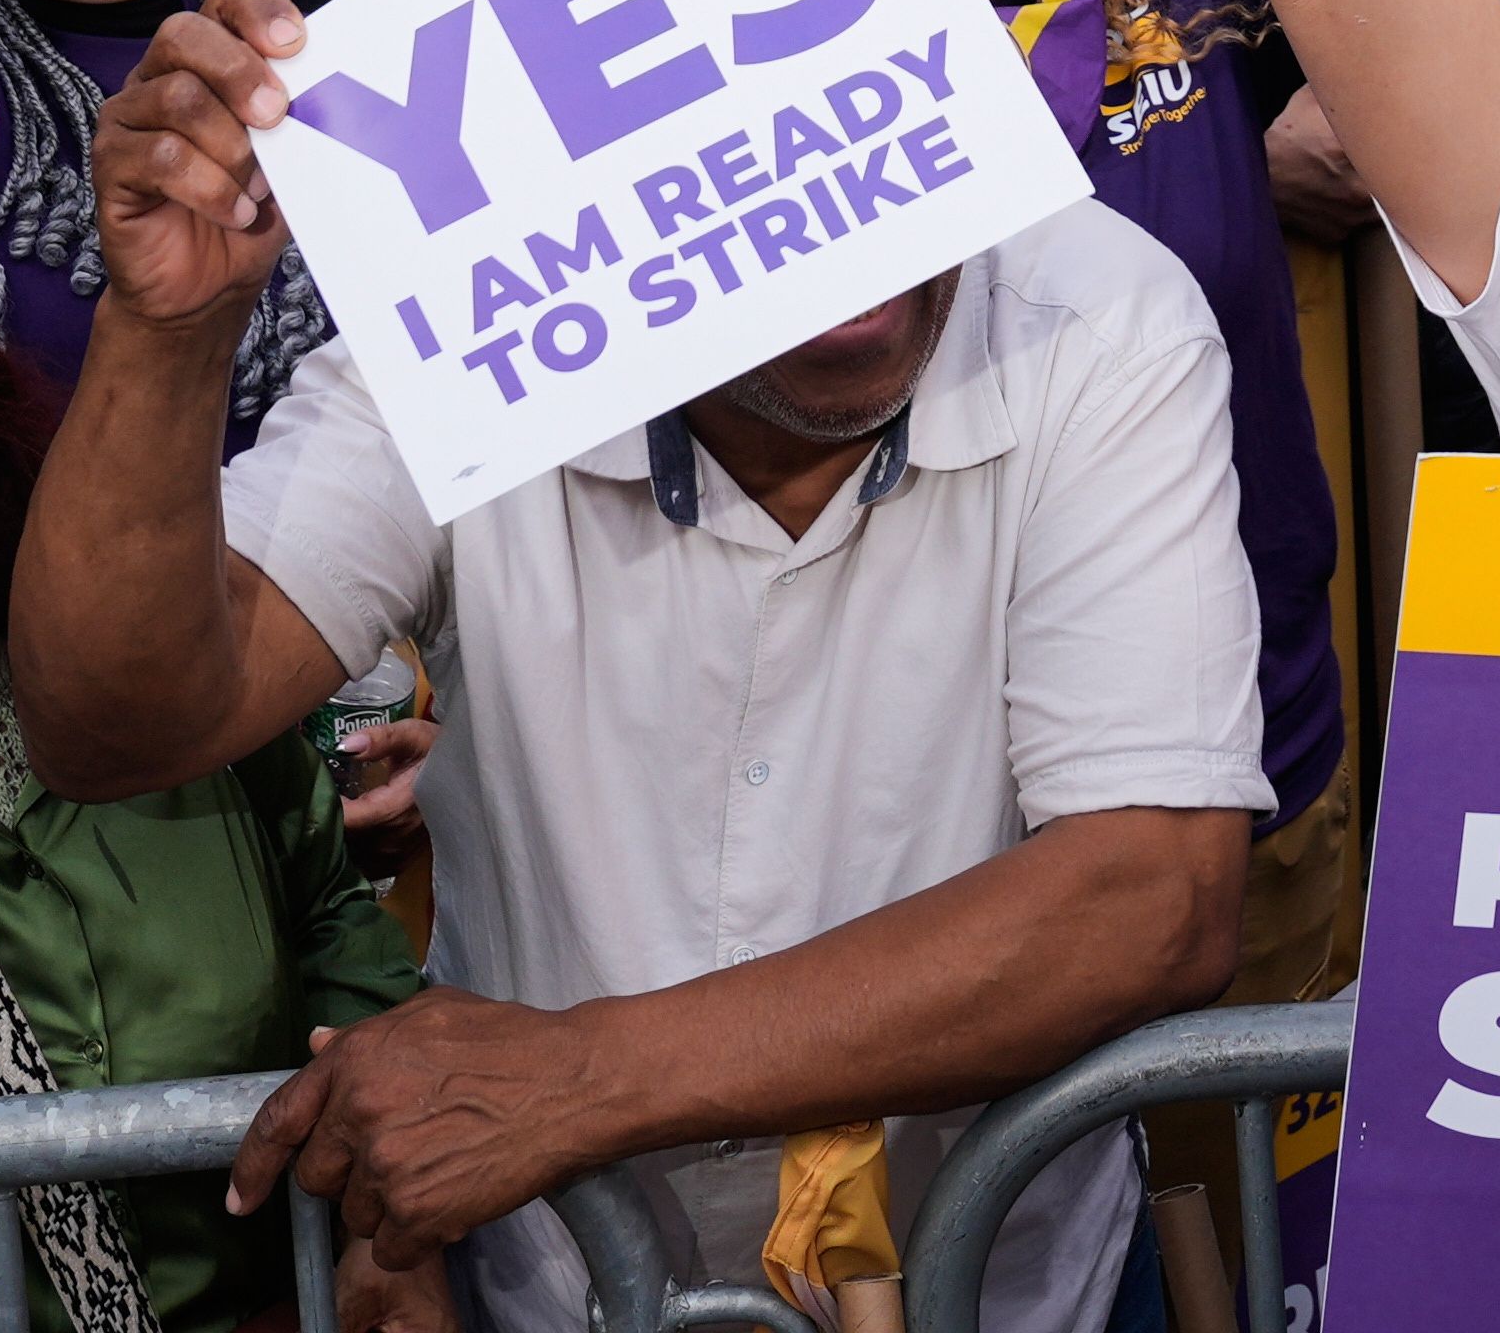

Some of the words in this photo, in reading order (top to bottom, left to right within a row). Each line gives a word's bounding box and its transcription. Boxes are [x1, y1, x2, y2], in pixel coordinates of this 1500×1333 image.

[460, 301, 609, 405] TO
[627, 115, 976, 330] STRIKE
[471, 204, 625, 335] AM
[631, 28, 958, 240] READY
